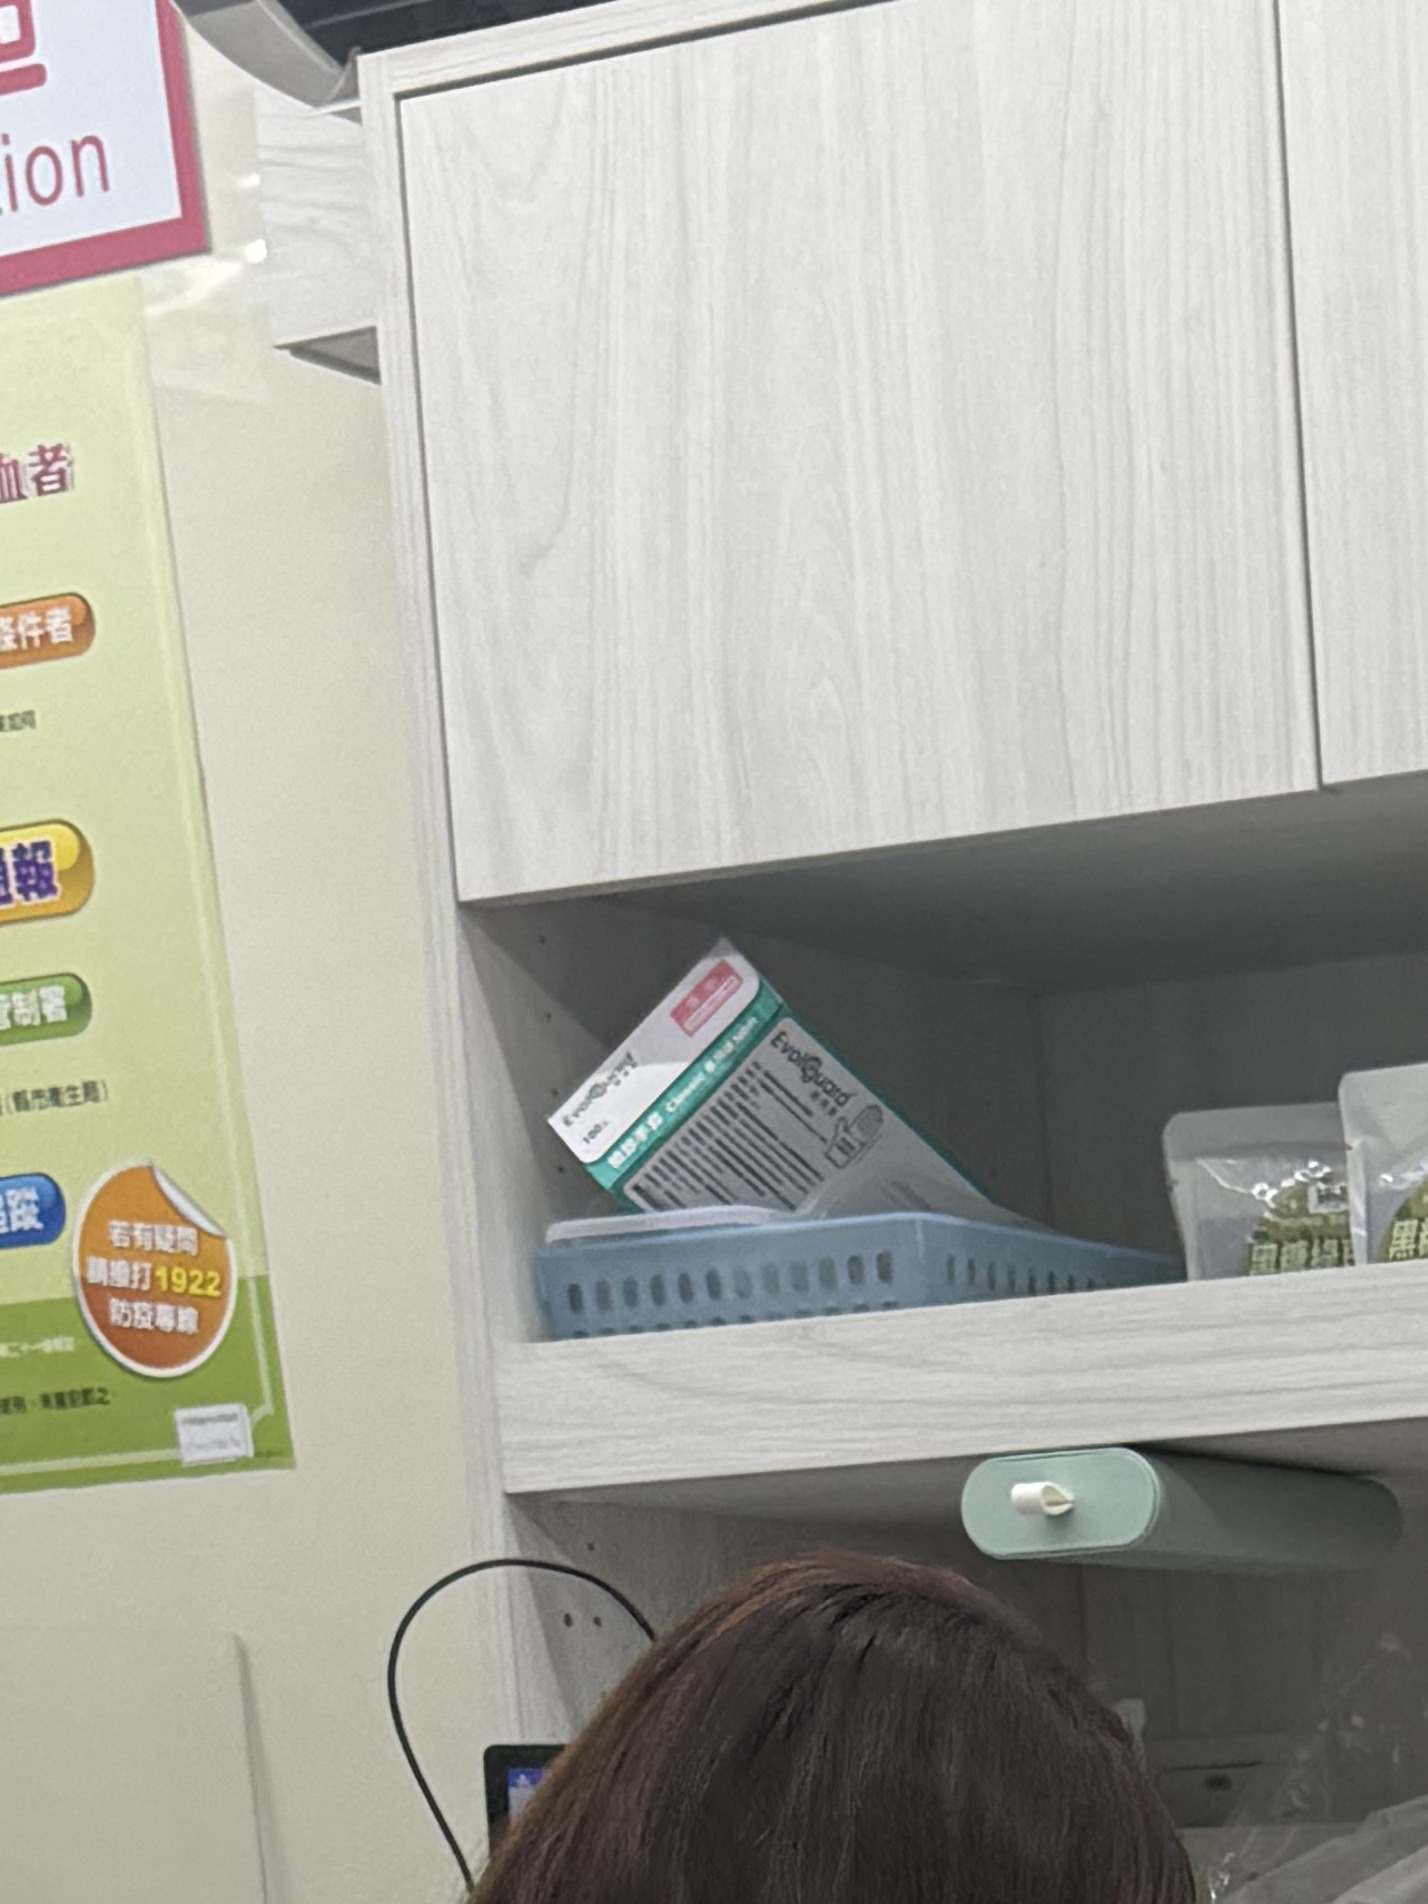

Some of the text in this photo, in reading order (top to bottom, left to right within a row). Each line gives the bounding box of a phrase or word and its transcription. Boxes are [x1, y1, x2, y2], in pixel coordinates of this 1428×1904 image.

[0, 133, 110, 215] ion
[0, 840, 58, 905] 報
[155, 1265, 222, 1297] 1922
